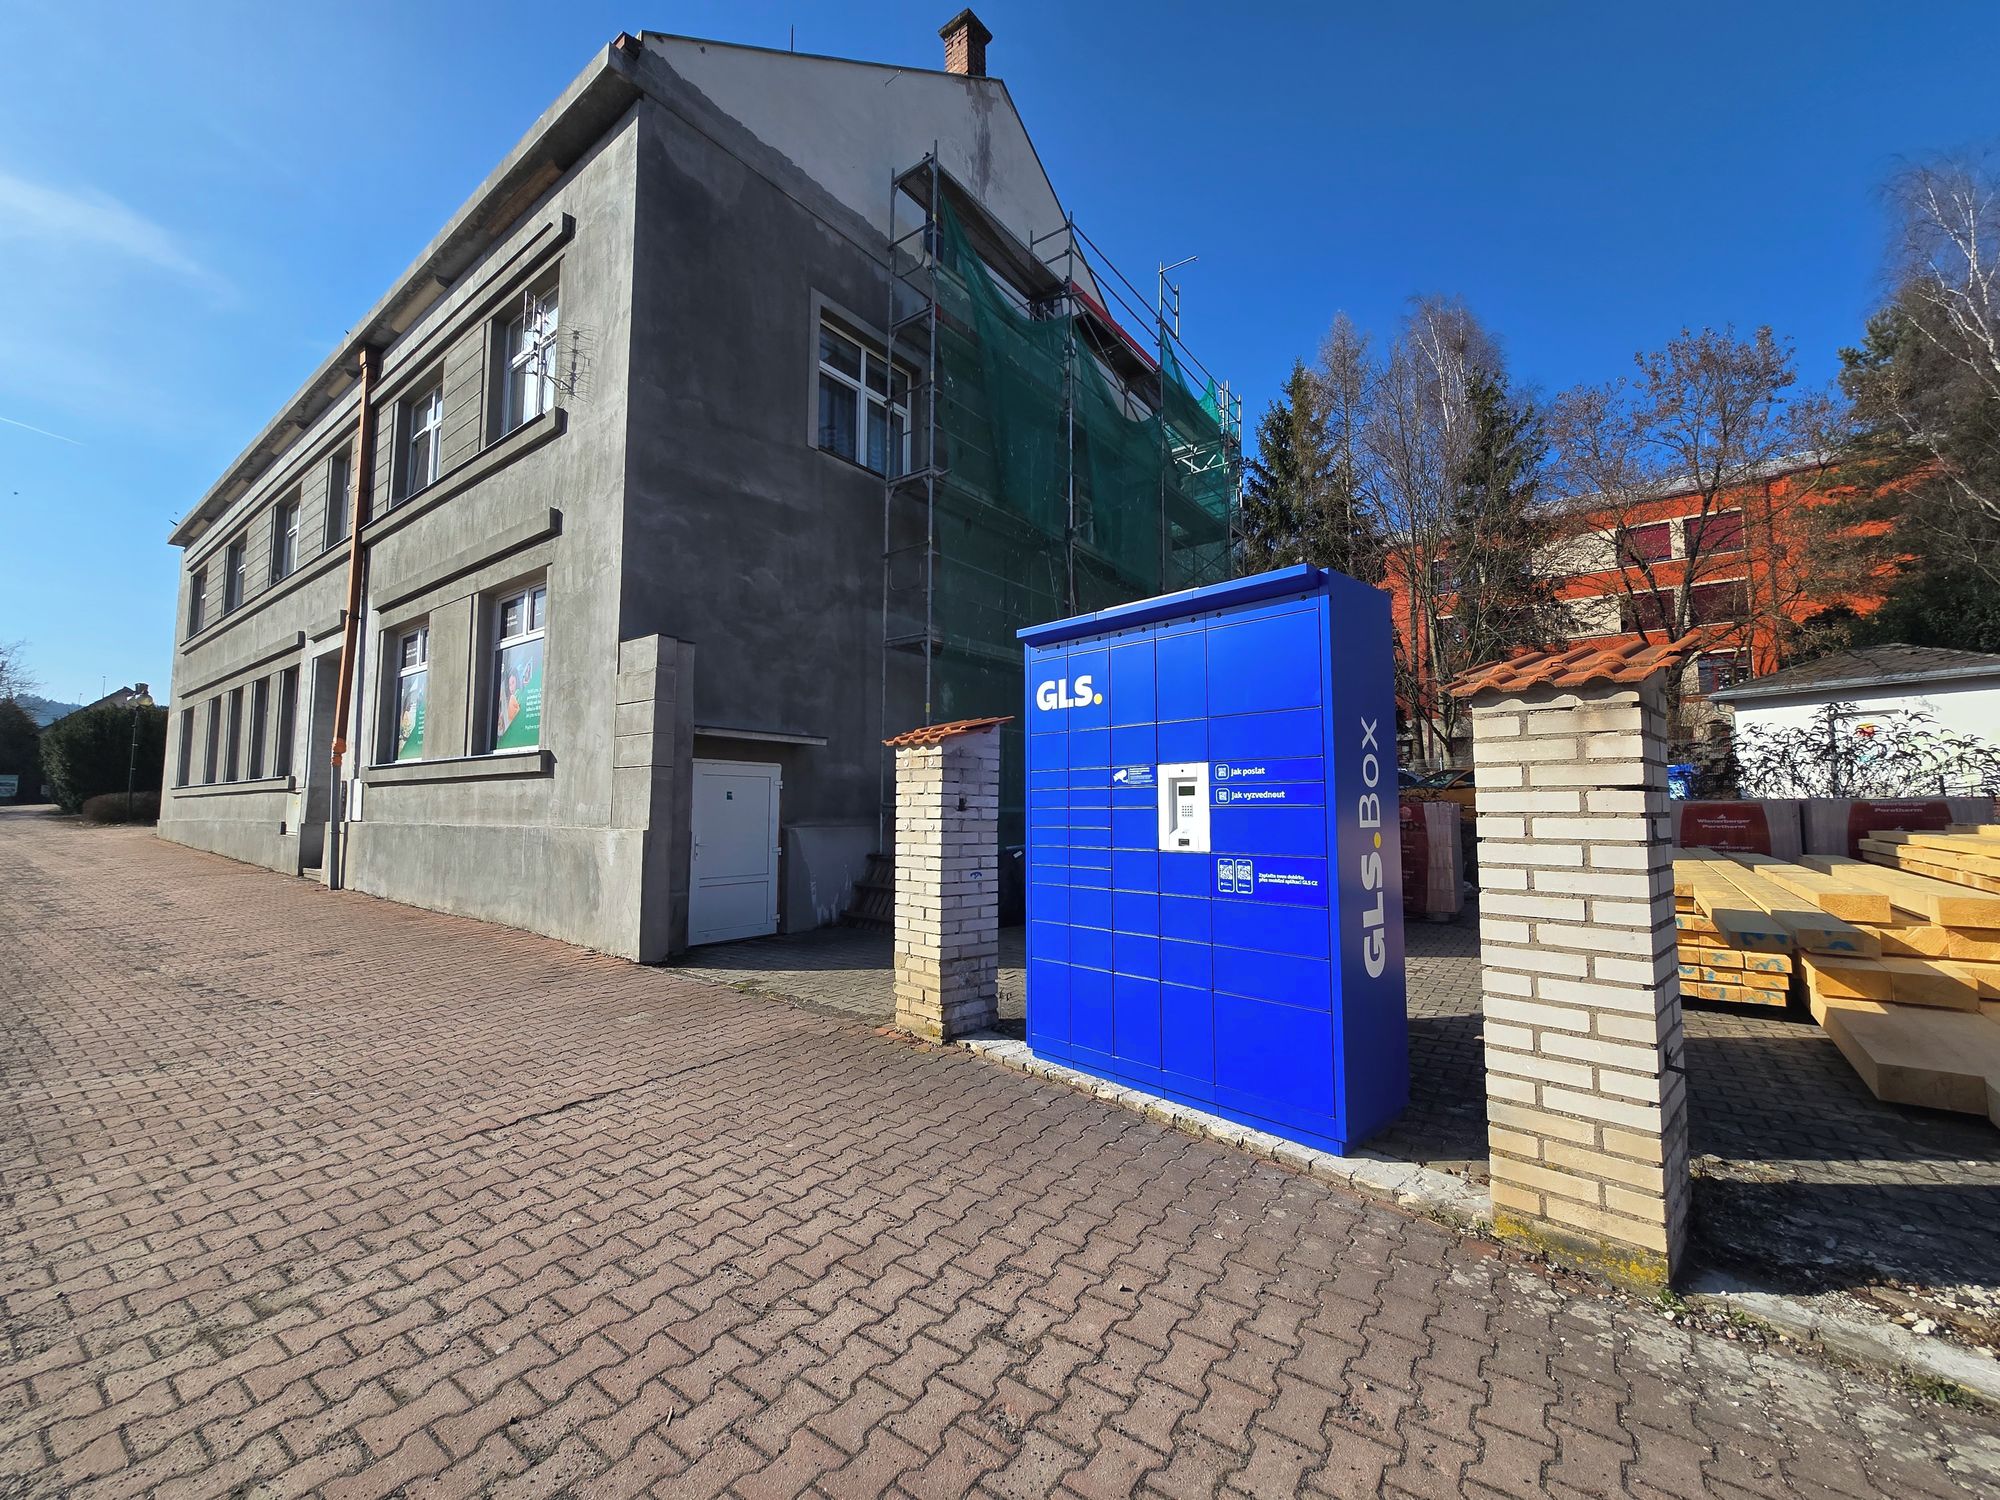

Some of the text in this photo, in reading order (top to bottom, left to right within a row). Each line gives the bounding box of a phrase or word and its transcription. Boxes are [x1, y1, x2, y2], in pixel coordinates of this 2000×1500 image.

[1036, 675, 1103, 711] GLS.
[1231, 767, 1265, 777] Jak poslat
[1231, 791, 1285, 800] Jak vyzvednout
